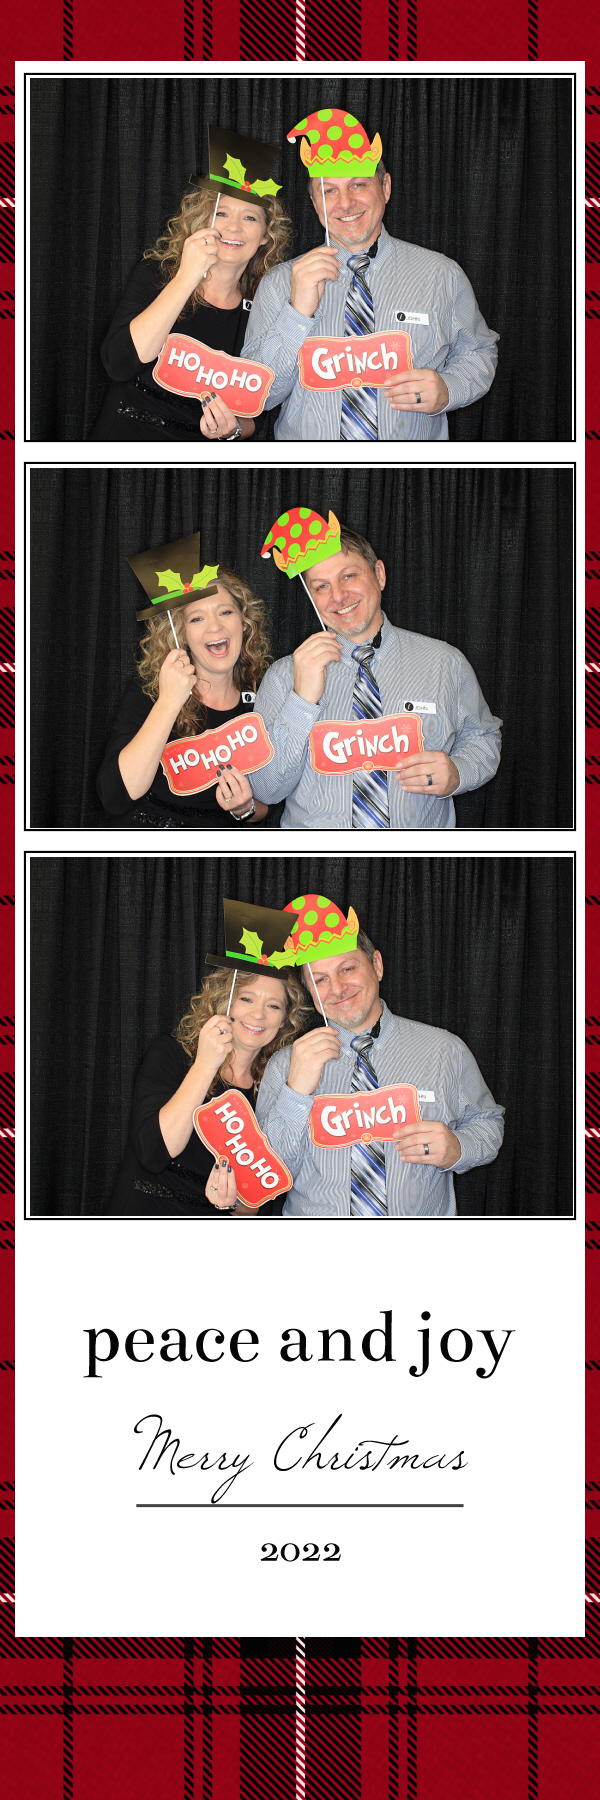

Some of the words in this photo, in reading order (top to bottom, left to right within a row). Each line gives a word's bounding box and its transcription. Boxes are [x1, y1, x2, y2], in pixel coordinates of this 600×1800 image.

[168, 348, 201, 371] HO
[196, 365, 228, 390] HO
[230, 369, 262, 392] HO
[169, 748, 200, 774] HO
[200, 744, 232, 770] HO
[226, 725, 258, 751] HO
[214, 1102, 244, 1134] HO
[225, 1134, 254, 1166] HO
[250, 1157, 279, 1189] HO
